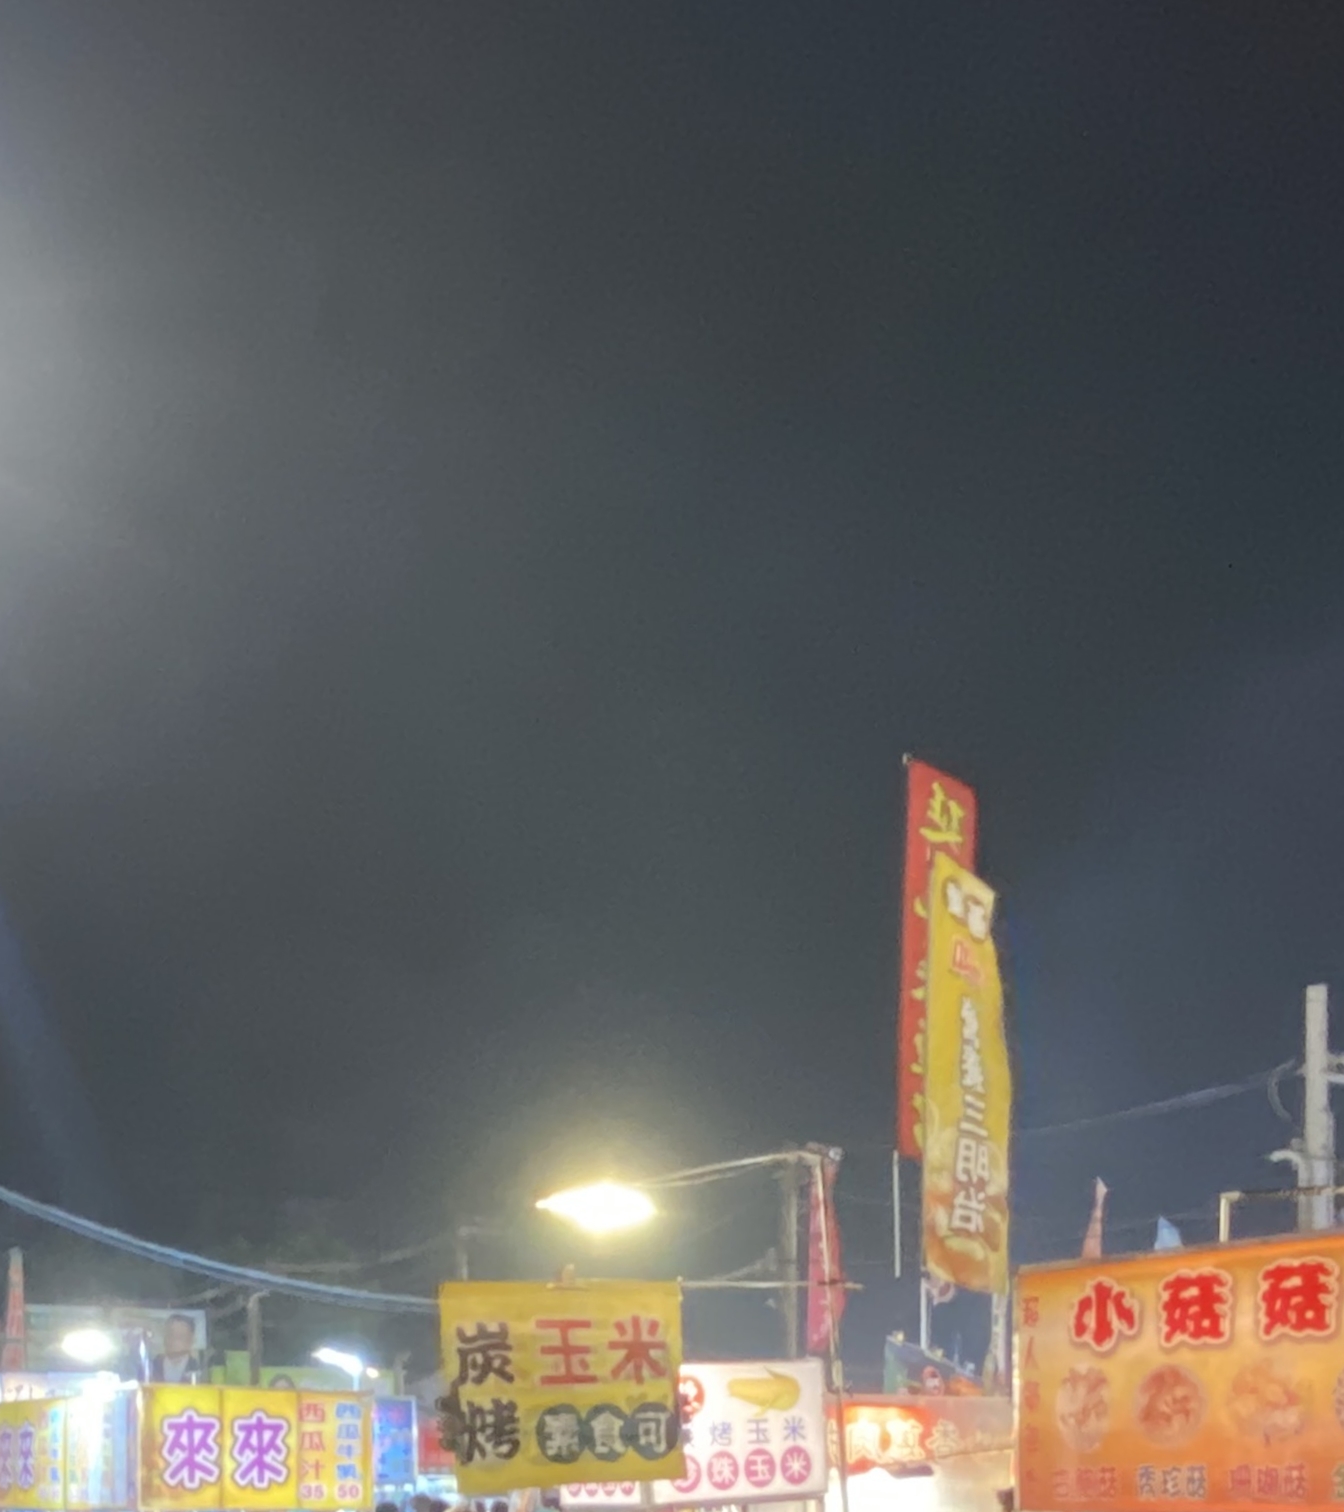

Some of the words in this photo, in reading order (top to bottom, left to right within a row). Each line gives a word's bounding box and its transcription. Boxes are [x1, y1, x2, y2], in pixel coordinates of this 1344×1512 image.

[1071, 1259, 1338, 1350] 小菇菇
[535, 1315, 667, 1386] 玉米
[163, 1409, 290, 1489] 來來
[298, 1403, 326, 1480] 西瓜汁
[299, 1484, 326, 1501] 35
[336, 1484, 362, 1501] 50
[1136, 1463, 1208, 1499] 秀珍菇
